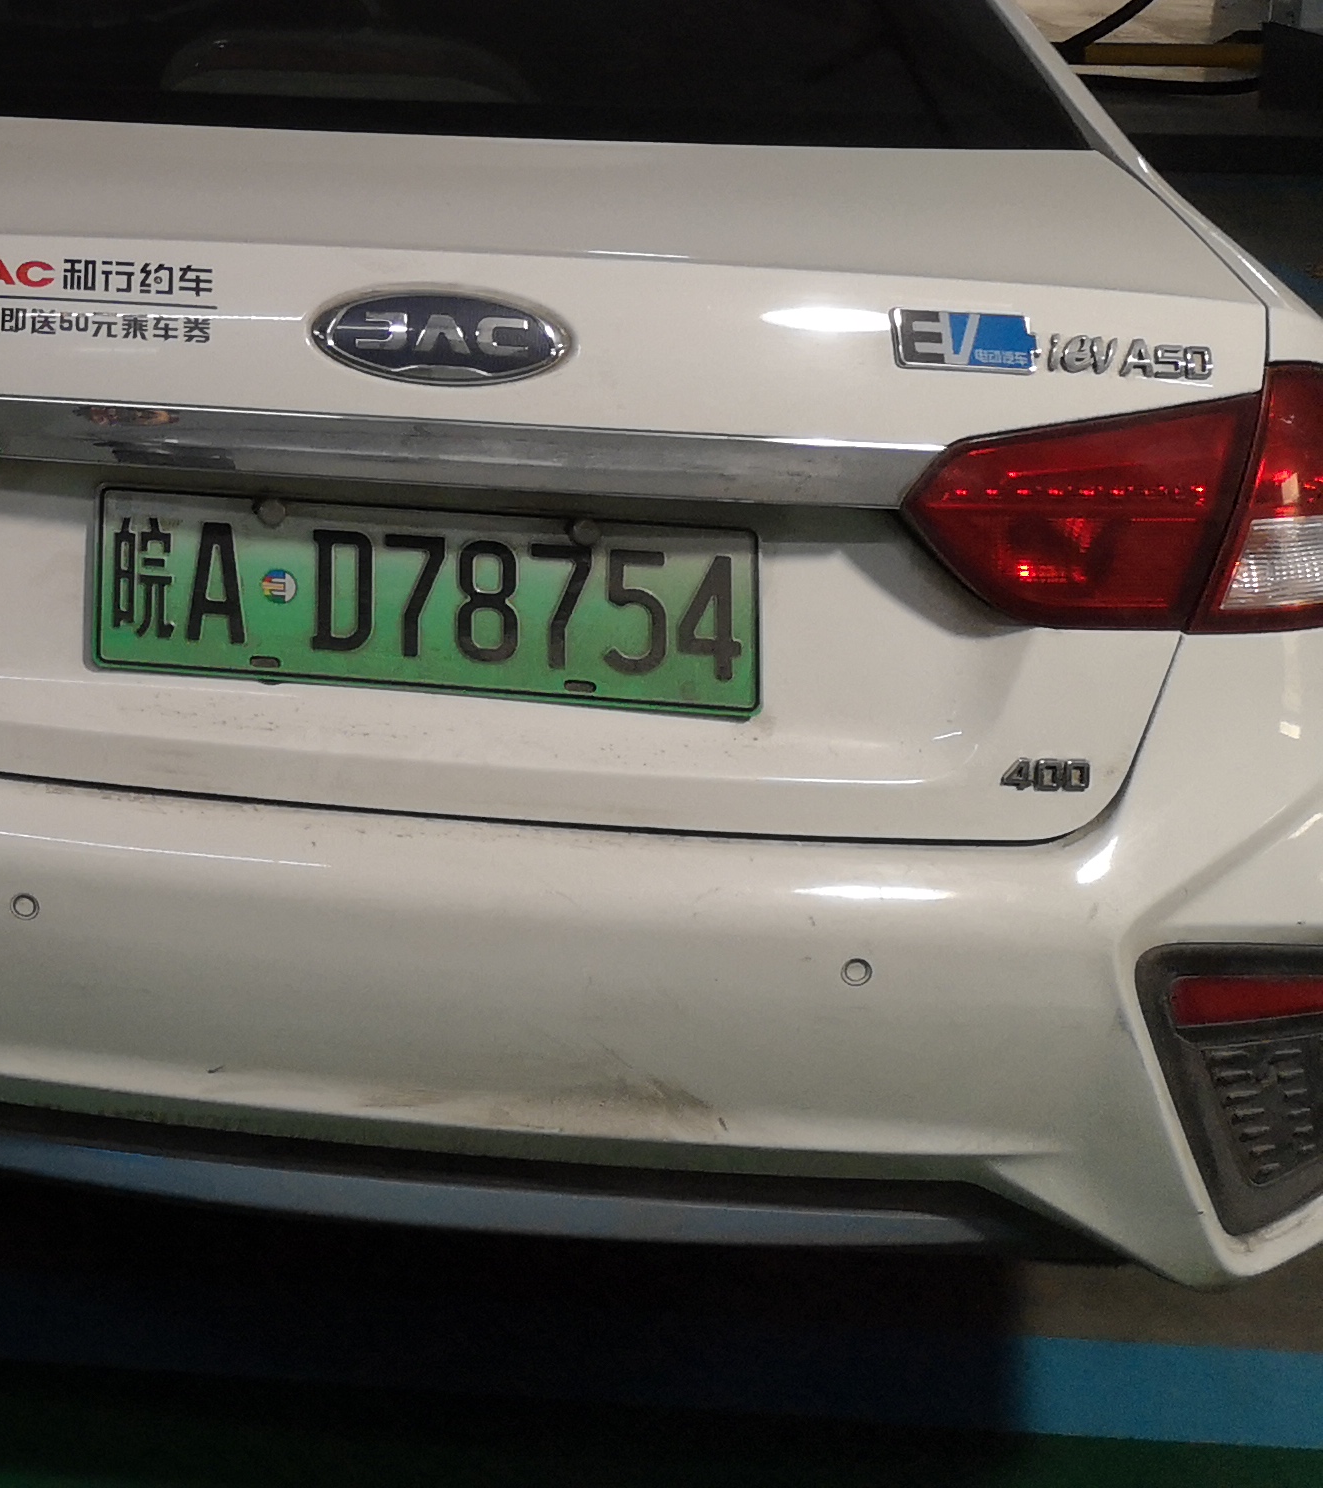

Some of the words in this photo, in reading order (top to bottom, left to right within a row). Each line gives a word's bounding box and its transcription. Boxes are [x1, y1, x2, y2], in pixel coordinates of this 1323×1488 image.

[62, 258, 213, 297] 和行约车
[974, 349, 1029, 366] 电动汽车
[112, 516, 248, 646] 皖A
[312, 528, 742, 683] D78754
[999, 757, 1091, 792] 400
